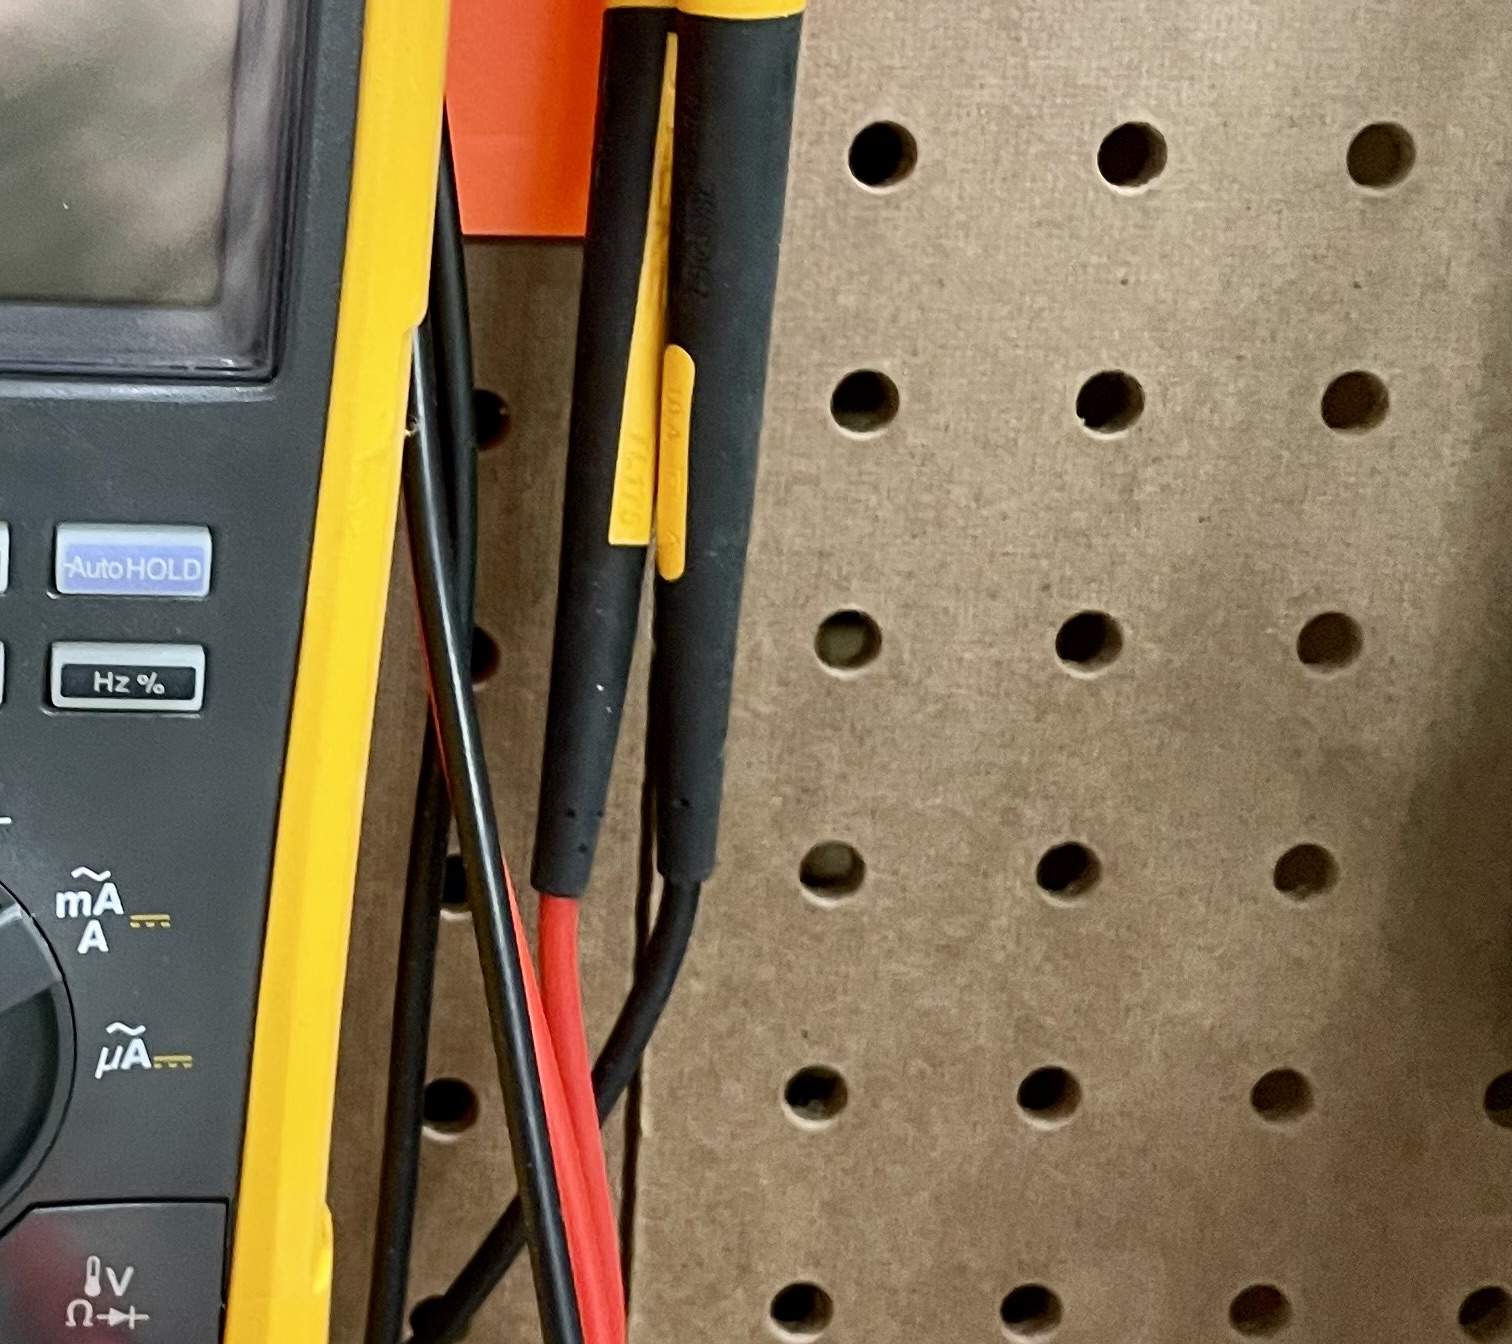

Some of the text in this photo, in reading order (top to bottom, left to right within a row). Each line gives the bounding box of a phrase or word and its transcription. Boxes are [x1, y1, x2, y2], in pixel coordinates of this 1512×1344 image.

[93, 670, 131, 693] Hz
[55, 882, 125, 919] mA
[77, 919, 110, 954] A
[105, 1266, 134, 1297] V
